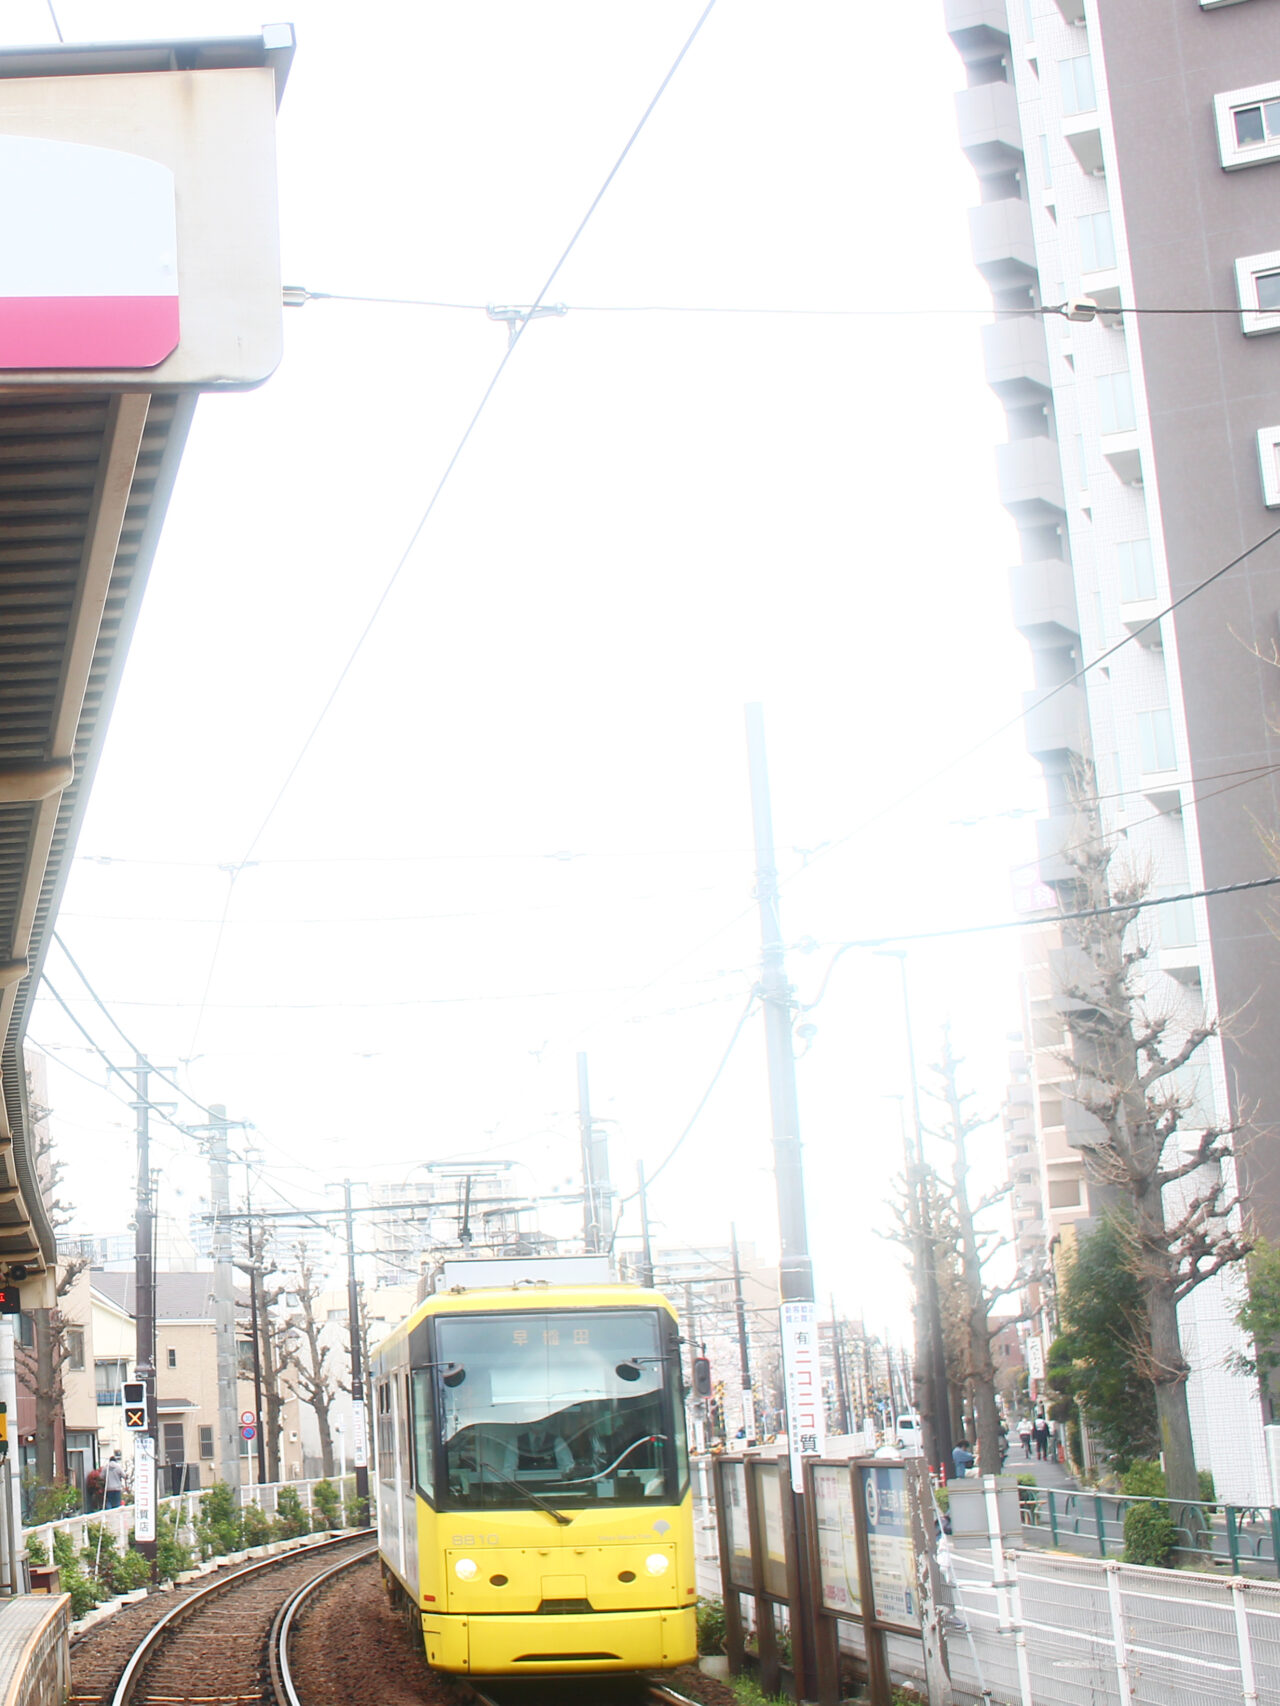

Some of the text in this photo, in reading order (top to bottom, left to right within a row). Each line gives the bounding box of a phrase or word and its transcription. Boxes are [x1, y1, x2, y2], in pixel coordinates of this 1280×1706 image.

[511, 1328, 591, 1347] 早稲田
[452, 1534, 499, 1546] 8810
